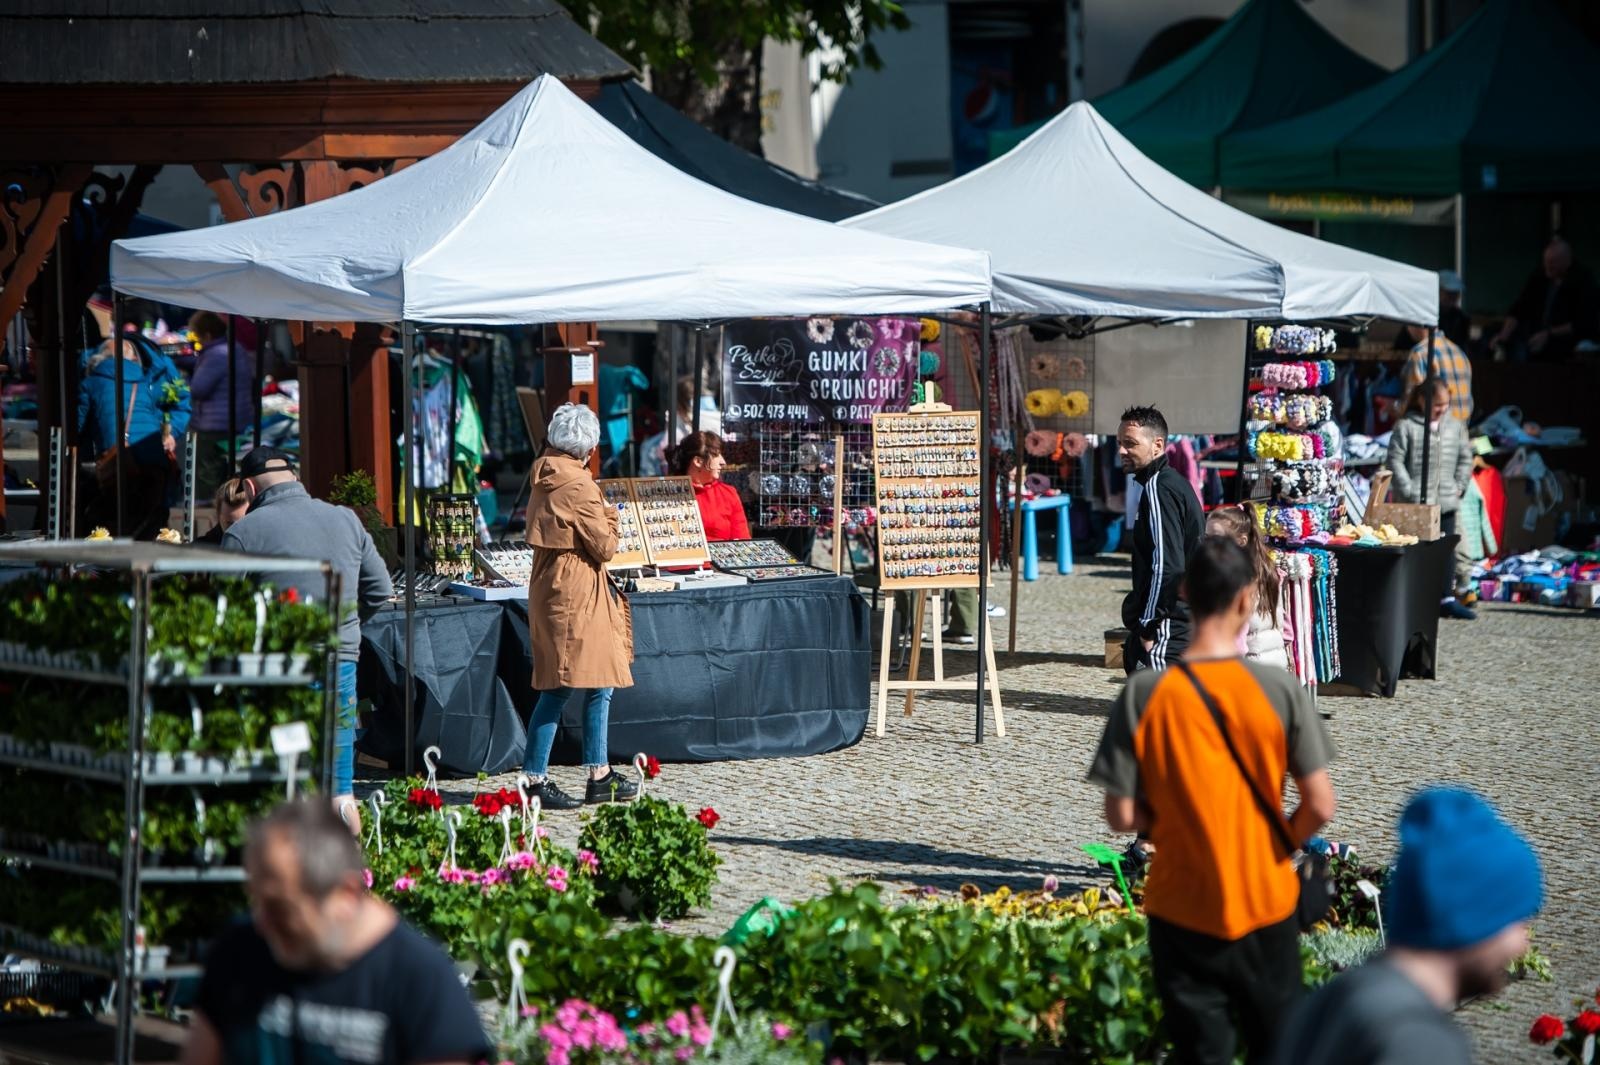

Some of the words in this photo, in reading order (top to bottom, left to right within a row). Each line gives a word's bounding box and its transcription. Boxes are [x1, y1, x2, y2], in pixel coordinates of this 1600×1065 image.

[808, 350, 868, 372] GUMKI
[810, 378, 906, 400] SCRUNCHIE
[743, 404, 764, 418] 502
[766, 404, 785, 419] 973
[787, 404, 809, 419] 444
